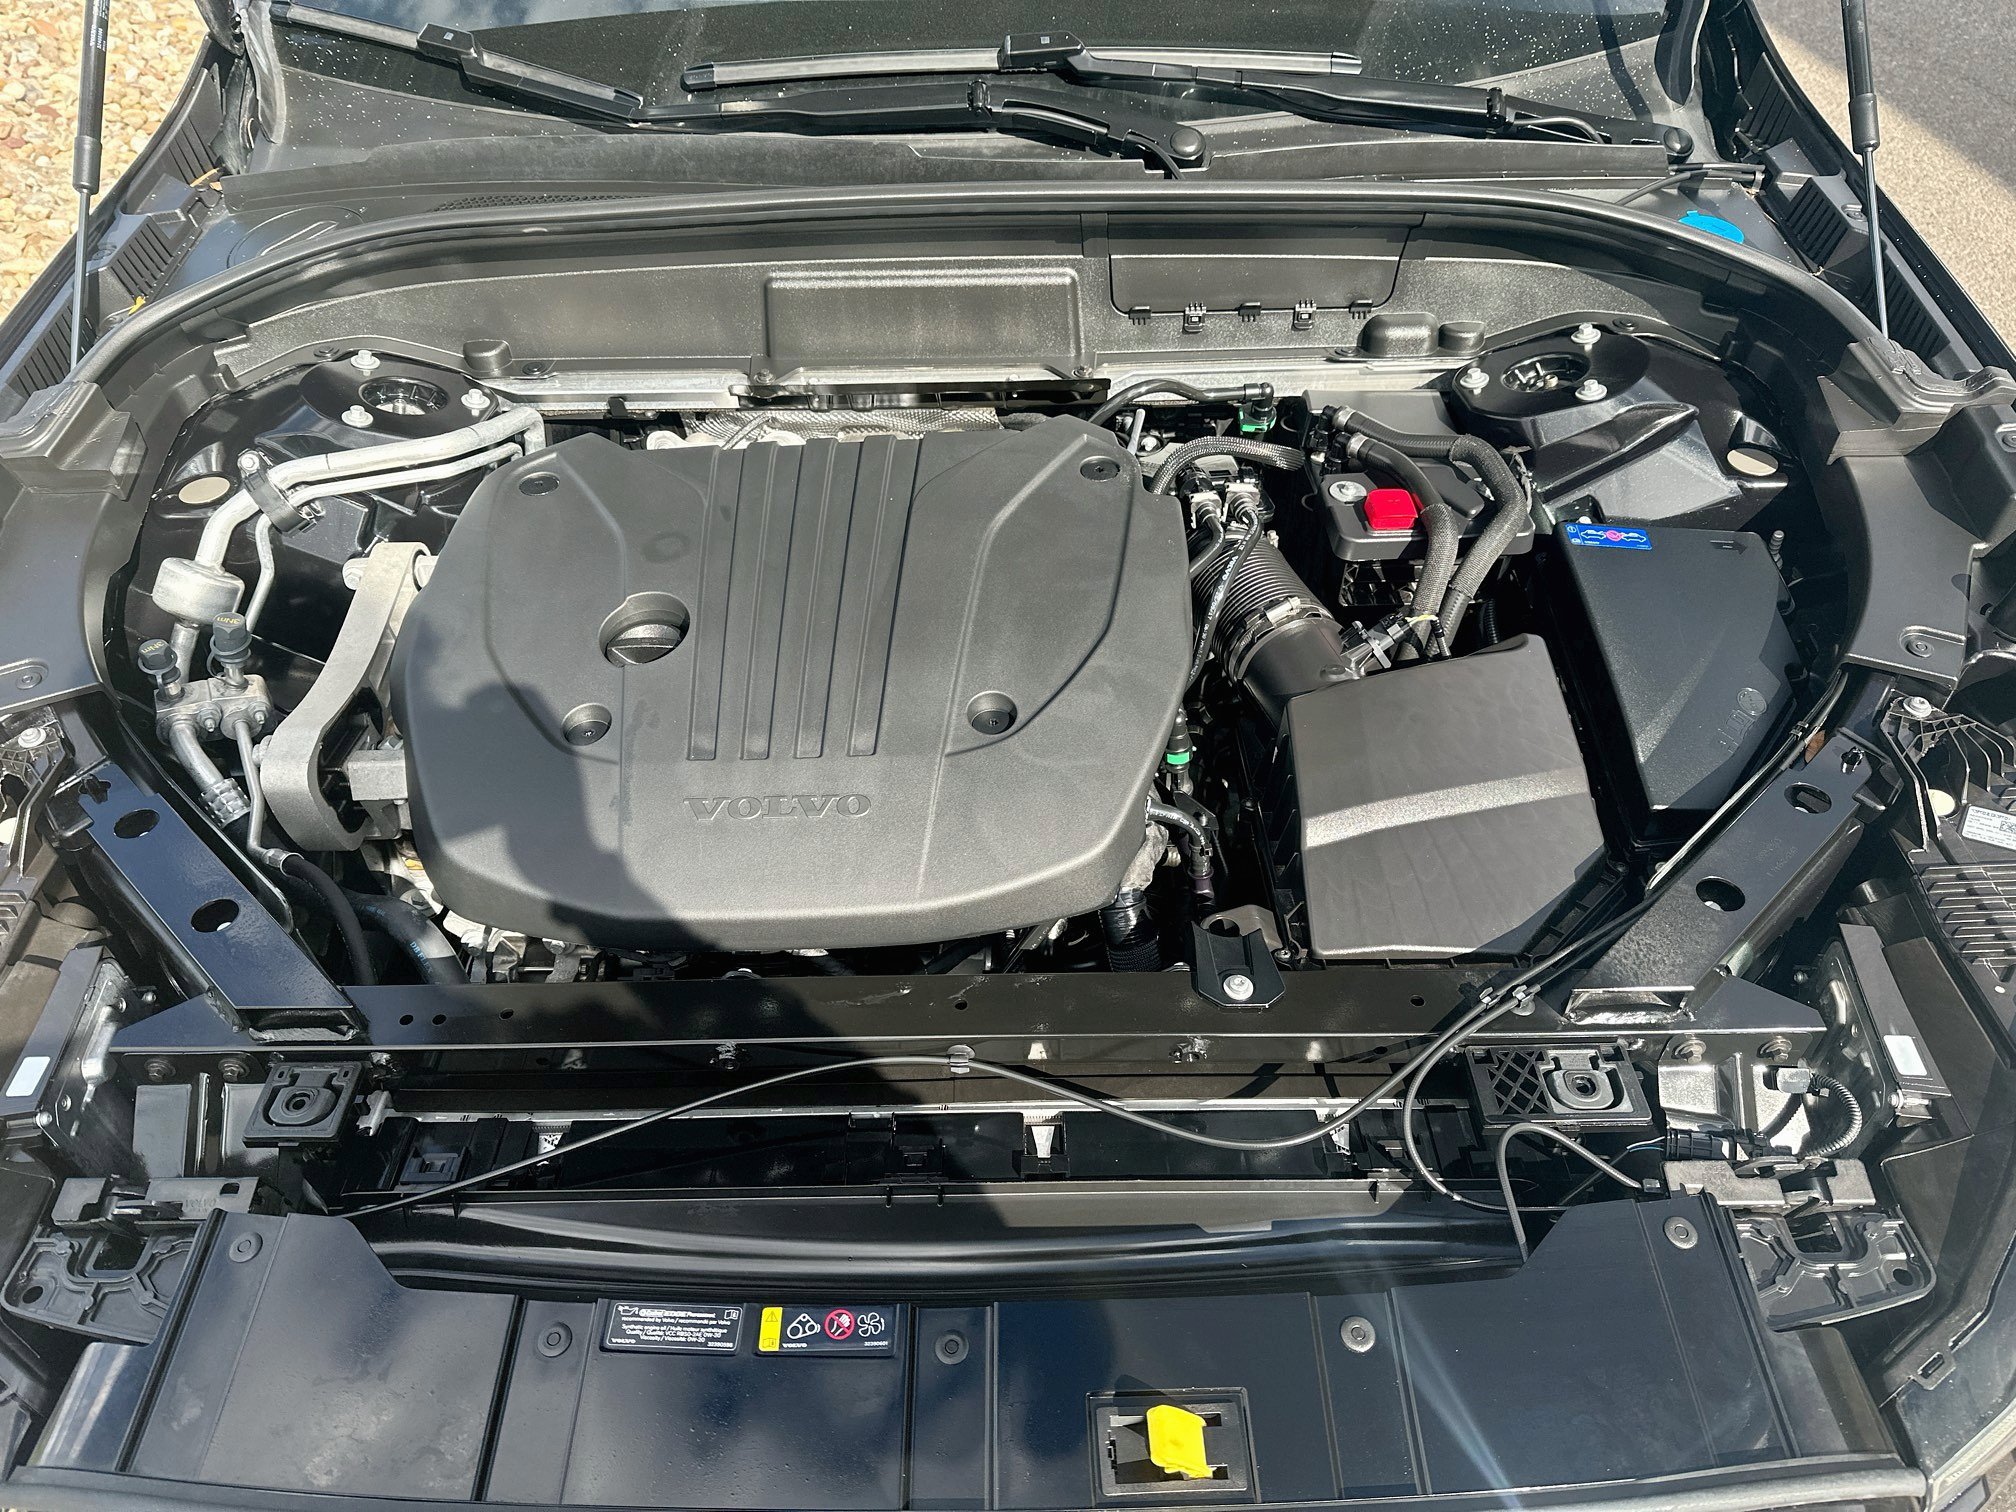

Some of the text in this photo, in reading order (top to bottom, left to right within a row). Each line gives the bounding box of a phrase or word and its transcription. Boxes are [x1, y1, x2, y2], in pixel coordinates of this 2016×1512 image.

[216, 616, 240, 624] 3Nm
[141, 641, 164, 654] 3Nm
[683, 793, 872, 821] VOLVO
